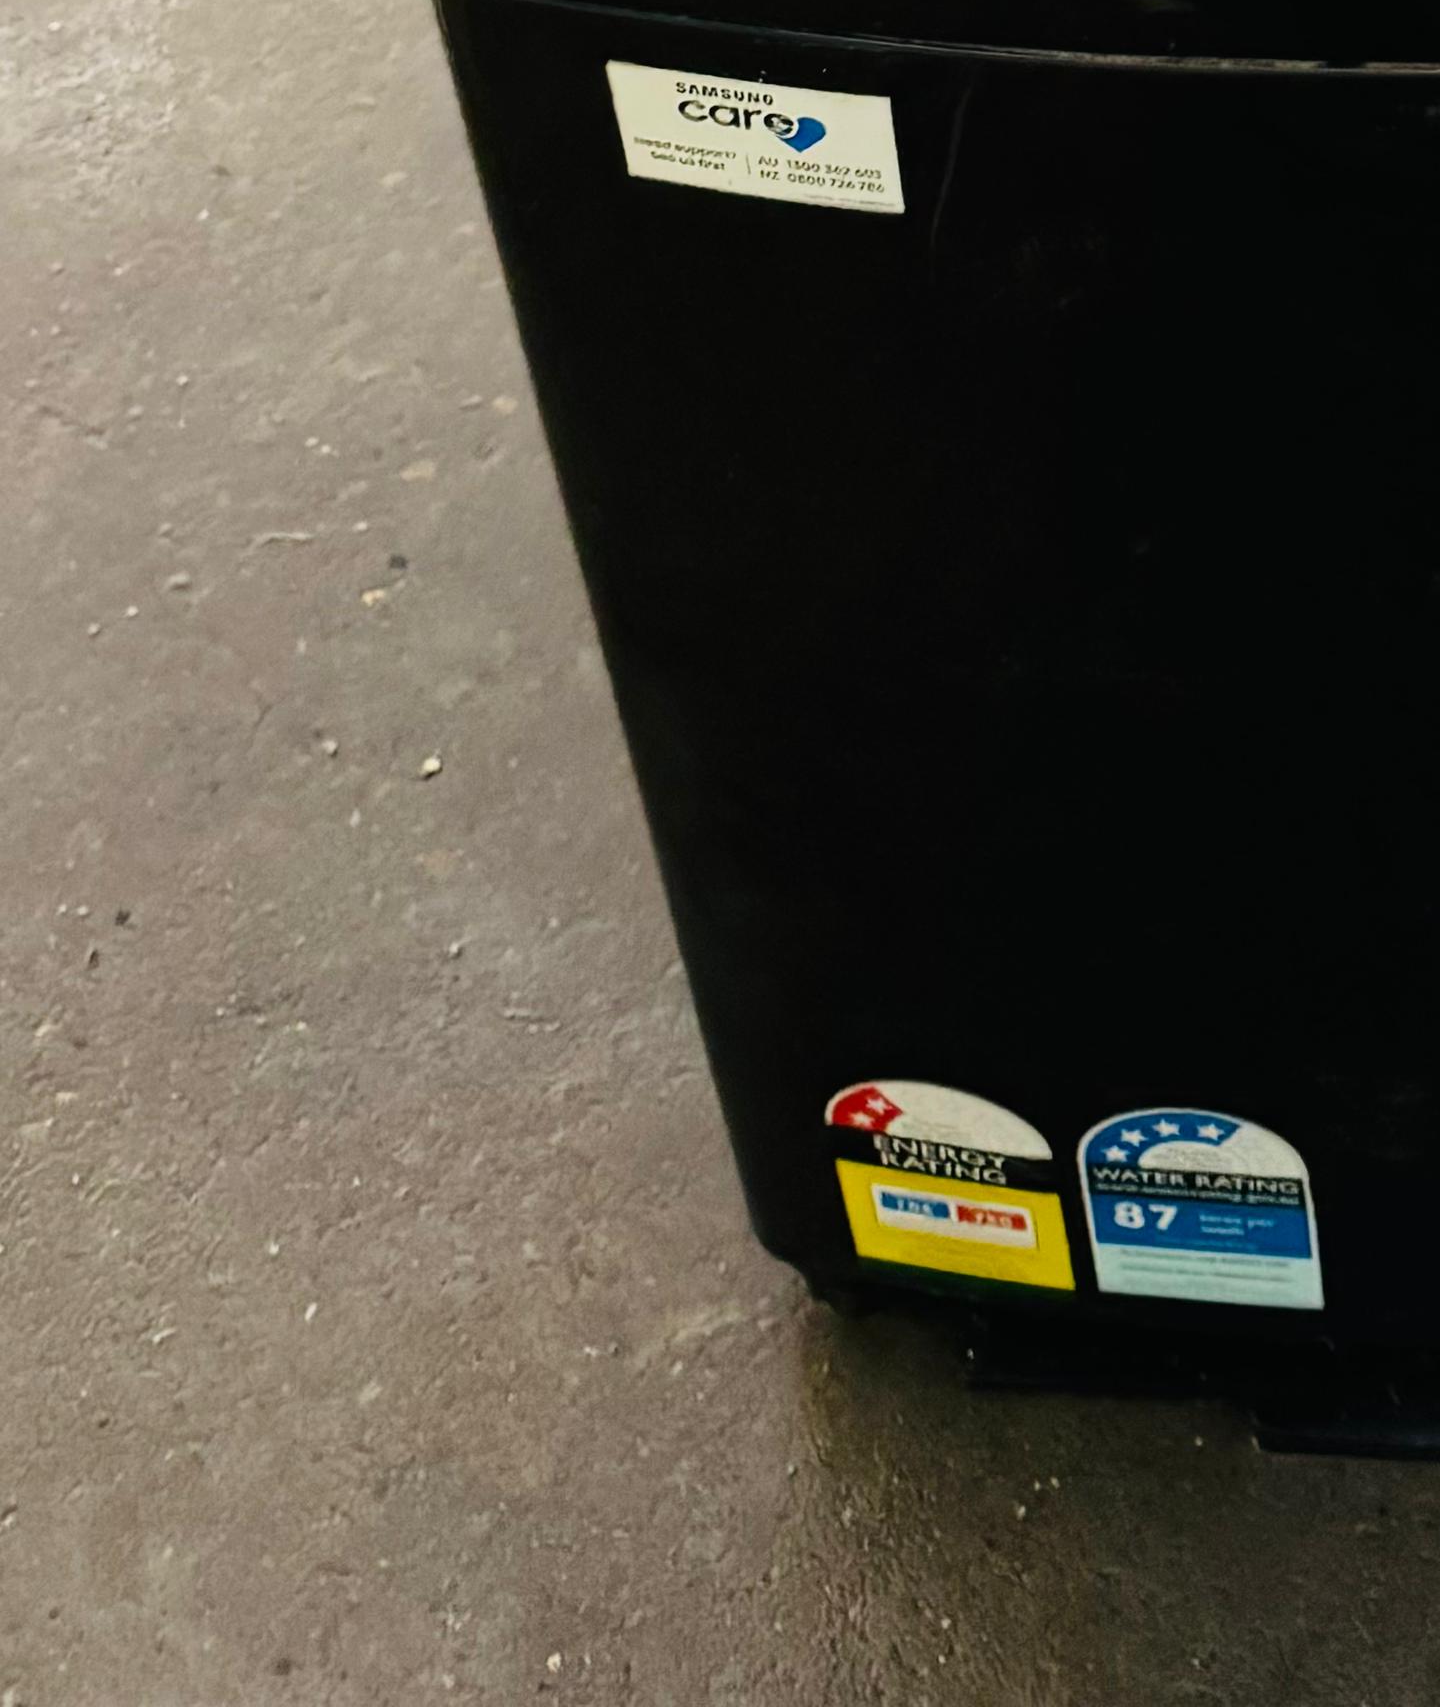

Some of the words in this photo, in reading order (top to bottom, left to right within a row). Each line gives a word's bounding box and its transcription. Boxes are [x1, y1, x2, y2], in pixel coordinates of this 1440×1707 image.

[676, 81, 774, 106] SAMSUNG
[677, 99, 795, 137] care
[872, 1134, 1006, 1169] ENERGY
[880, 1151, 1007, 1186] RATING
[1093, 1166, 1187, 1187] WATER
[1194, 1173, 1300, 1195] RATING
[1113, 1200, 1179, 1231] 87
